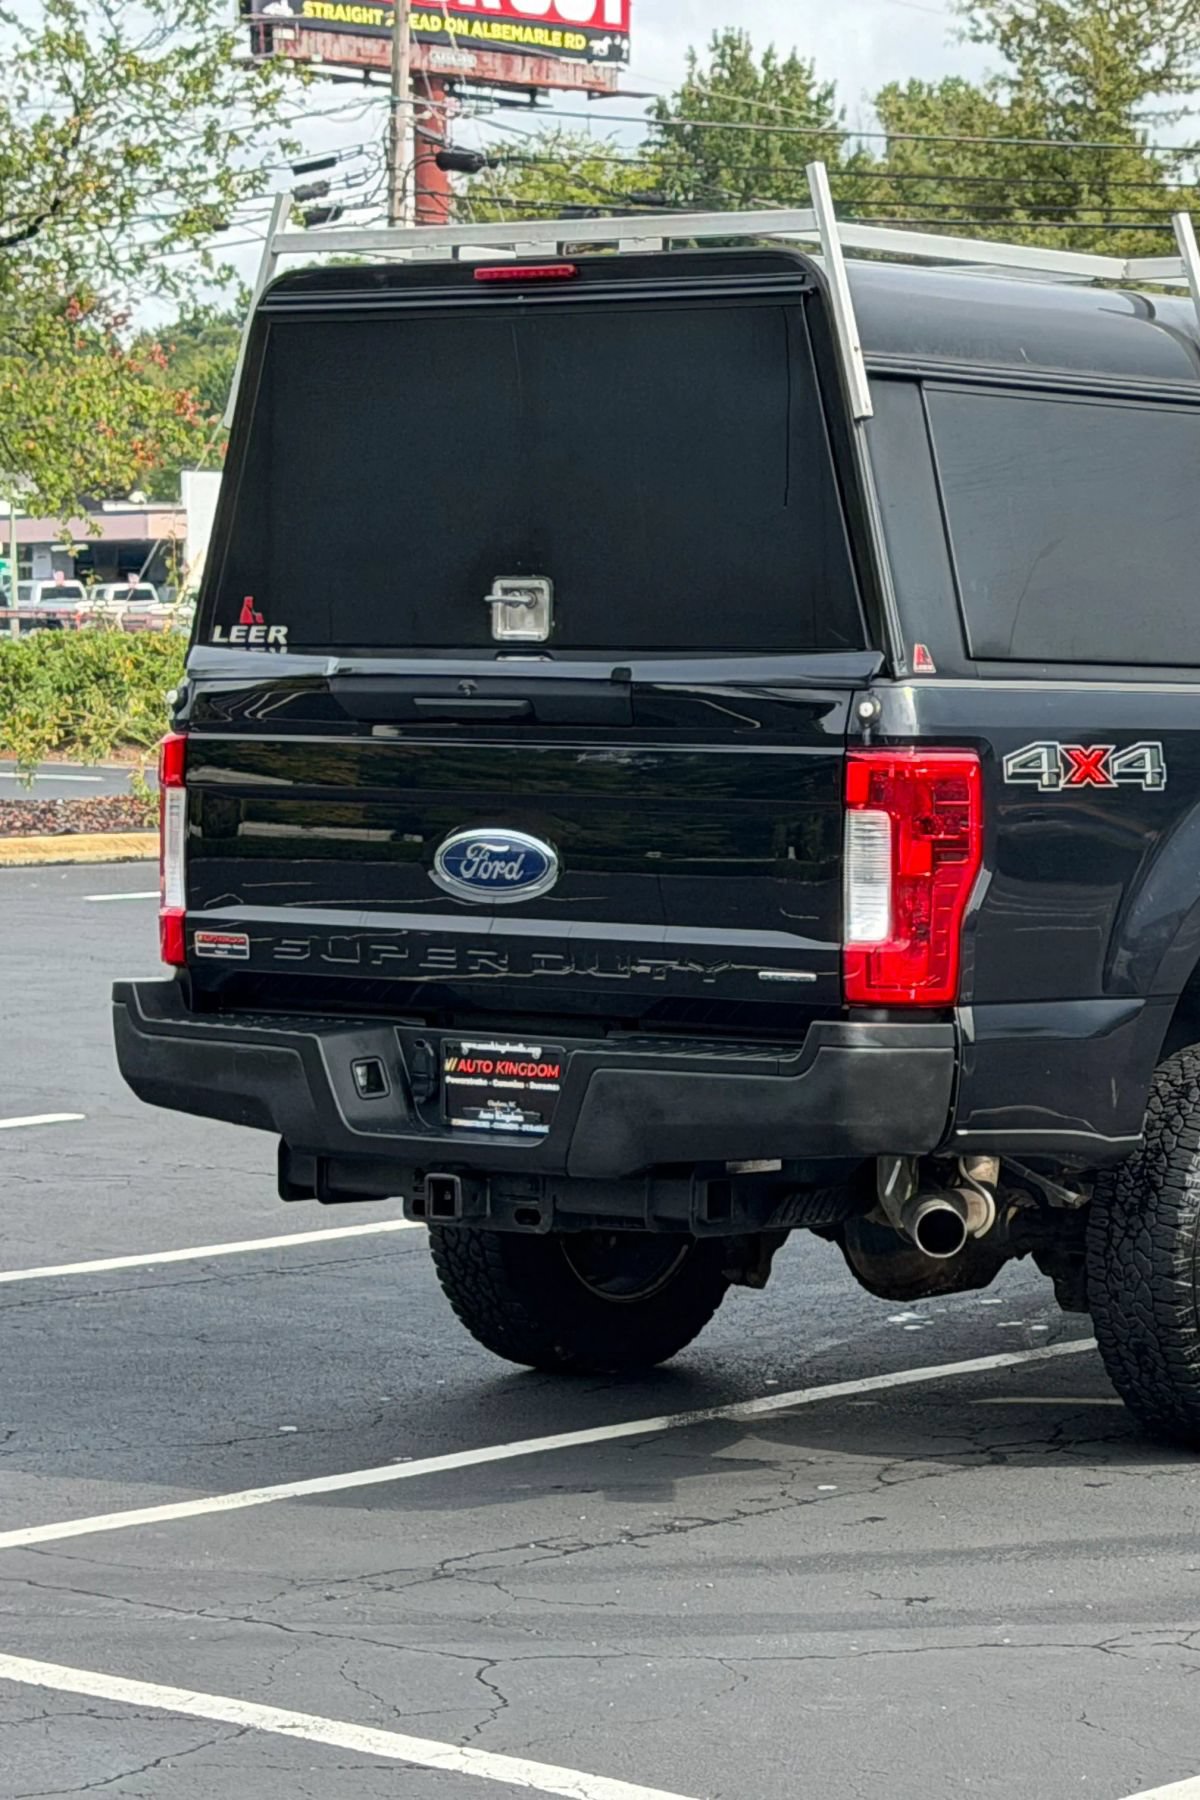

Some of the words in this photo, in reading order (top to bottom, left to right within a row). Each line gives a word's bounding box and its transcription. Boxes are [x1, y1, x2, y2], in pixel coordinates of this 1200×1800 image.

[302, 2, 384, 26] STRAIGHT
[444, 17, 468, 35] ON
[470, 20, 563, 47] ALBEMARLE
[563, 32, 587, 51] RD
[212, 624, 289, 645] LEER
[460, 842, 525, 880] Ford
[273, 937, 508, 971] SUPER
[530, 950, 732, 983] DUTY
[457, 1059, 493, 1074] AUTO
[495, 1061, 560, 1078] KINGDOM
